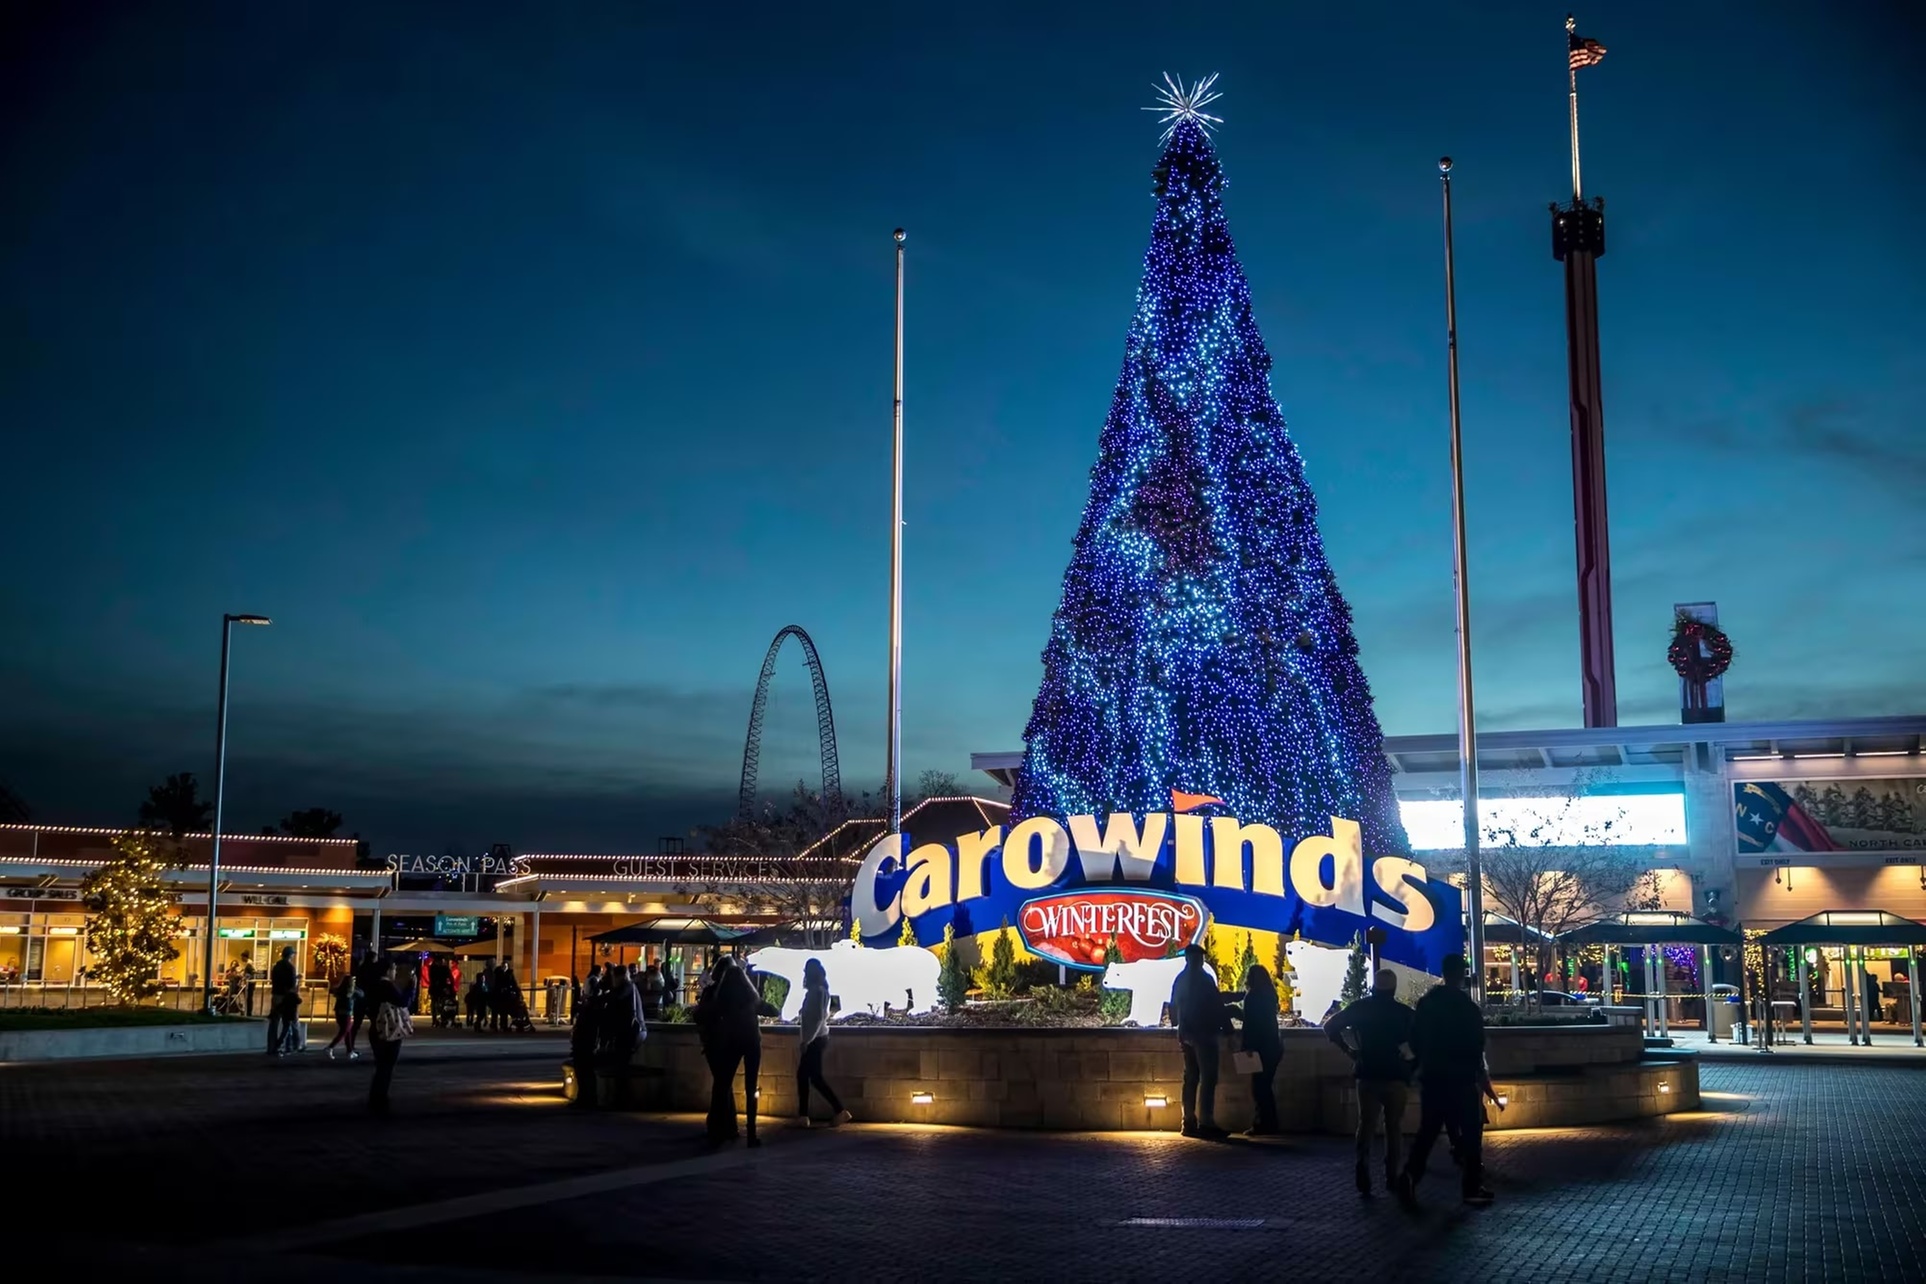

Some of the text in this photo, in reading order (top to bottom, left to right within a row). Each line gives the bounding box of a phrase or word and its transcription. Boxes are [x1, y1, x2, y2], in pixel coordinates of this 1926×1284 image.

[1735, 802, 1775, 834] N C
[1849, 839, 1898, 848] NORTH
[386, 854, 532, 876] SEASON PASS
[613, 858, 780, 879] GUEST SERVICES
[851, 811, 1436, 937] Carowinds
[1024, 900, 1196, 947] WINTERFEST
